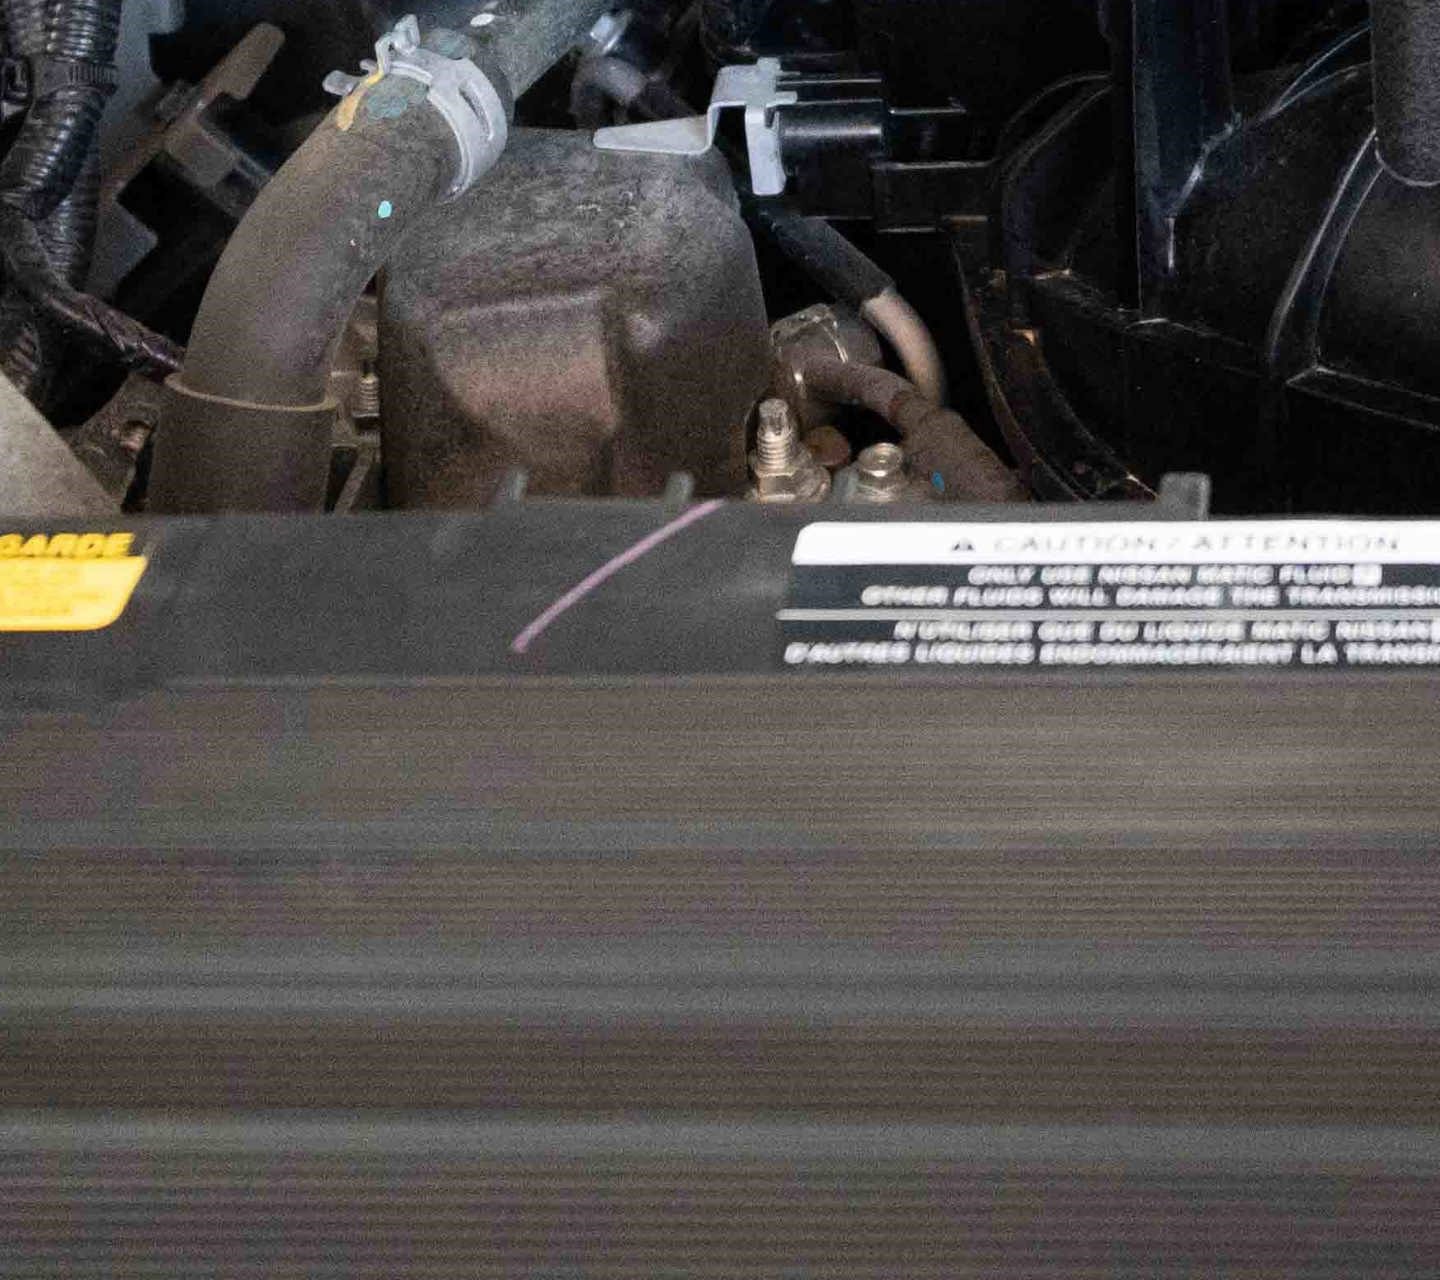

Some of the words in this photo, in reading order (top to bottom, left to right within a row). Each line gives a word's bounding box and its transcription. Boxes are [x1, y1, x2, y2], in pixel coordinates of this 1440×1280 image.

[993, 536, 1157, 552] CAUTION
[1192, 536, 1401, 552] ATTENTION
[968, 564, 1036, 586] ONLY
[1040, 564, 1094, 586] USE
[1097, 564, 1193, 586] NISSAN
[861, 585, 949, 608] OTHER
[953, 585, 1044, 608] FLUIDS
[1048, 585, 1108, 608] WILL
[1115, 585, 1223, 608] DAMAGE
[1231, 585, 1280, 608] THE
[1099, 620, 1140, 642] DU
[1300, 641, 1338, 666] LA
